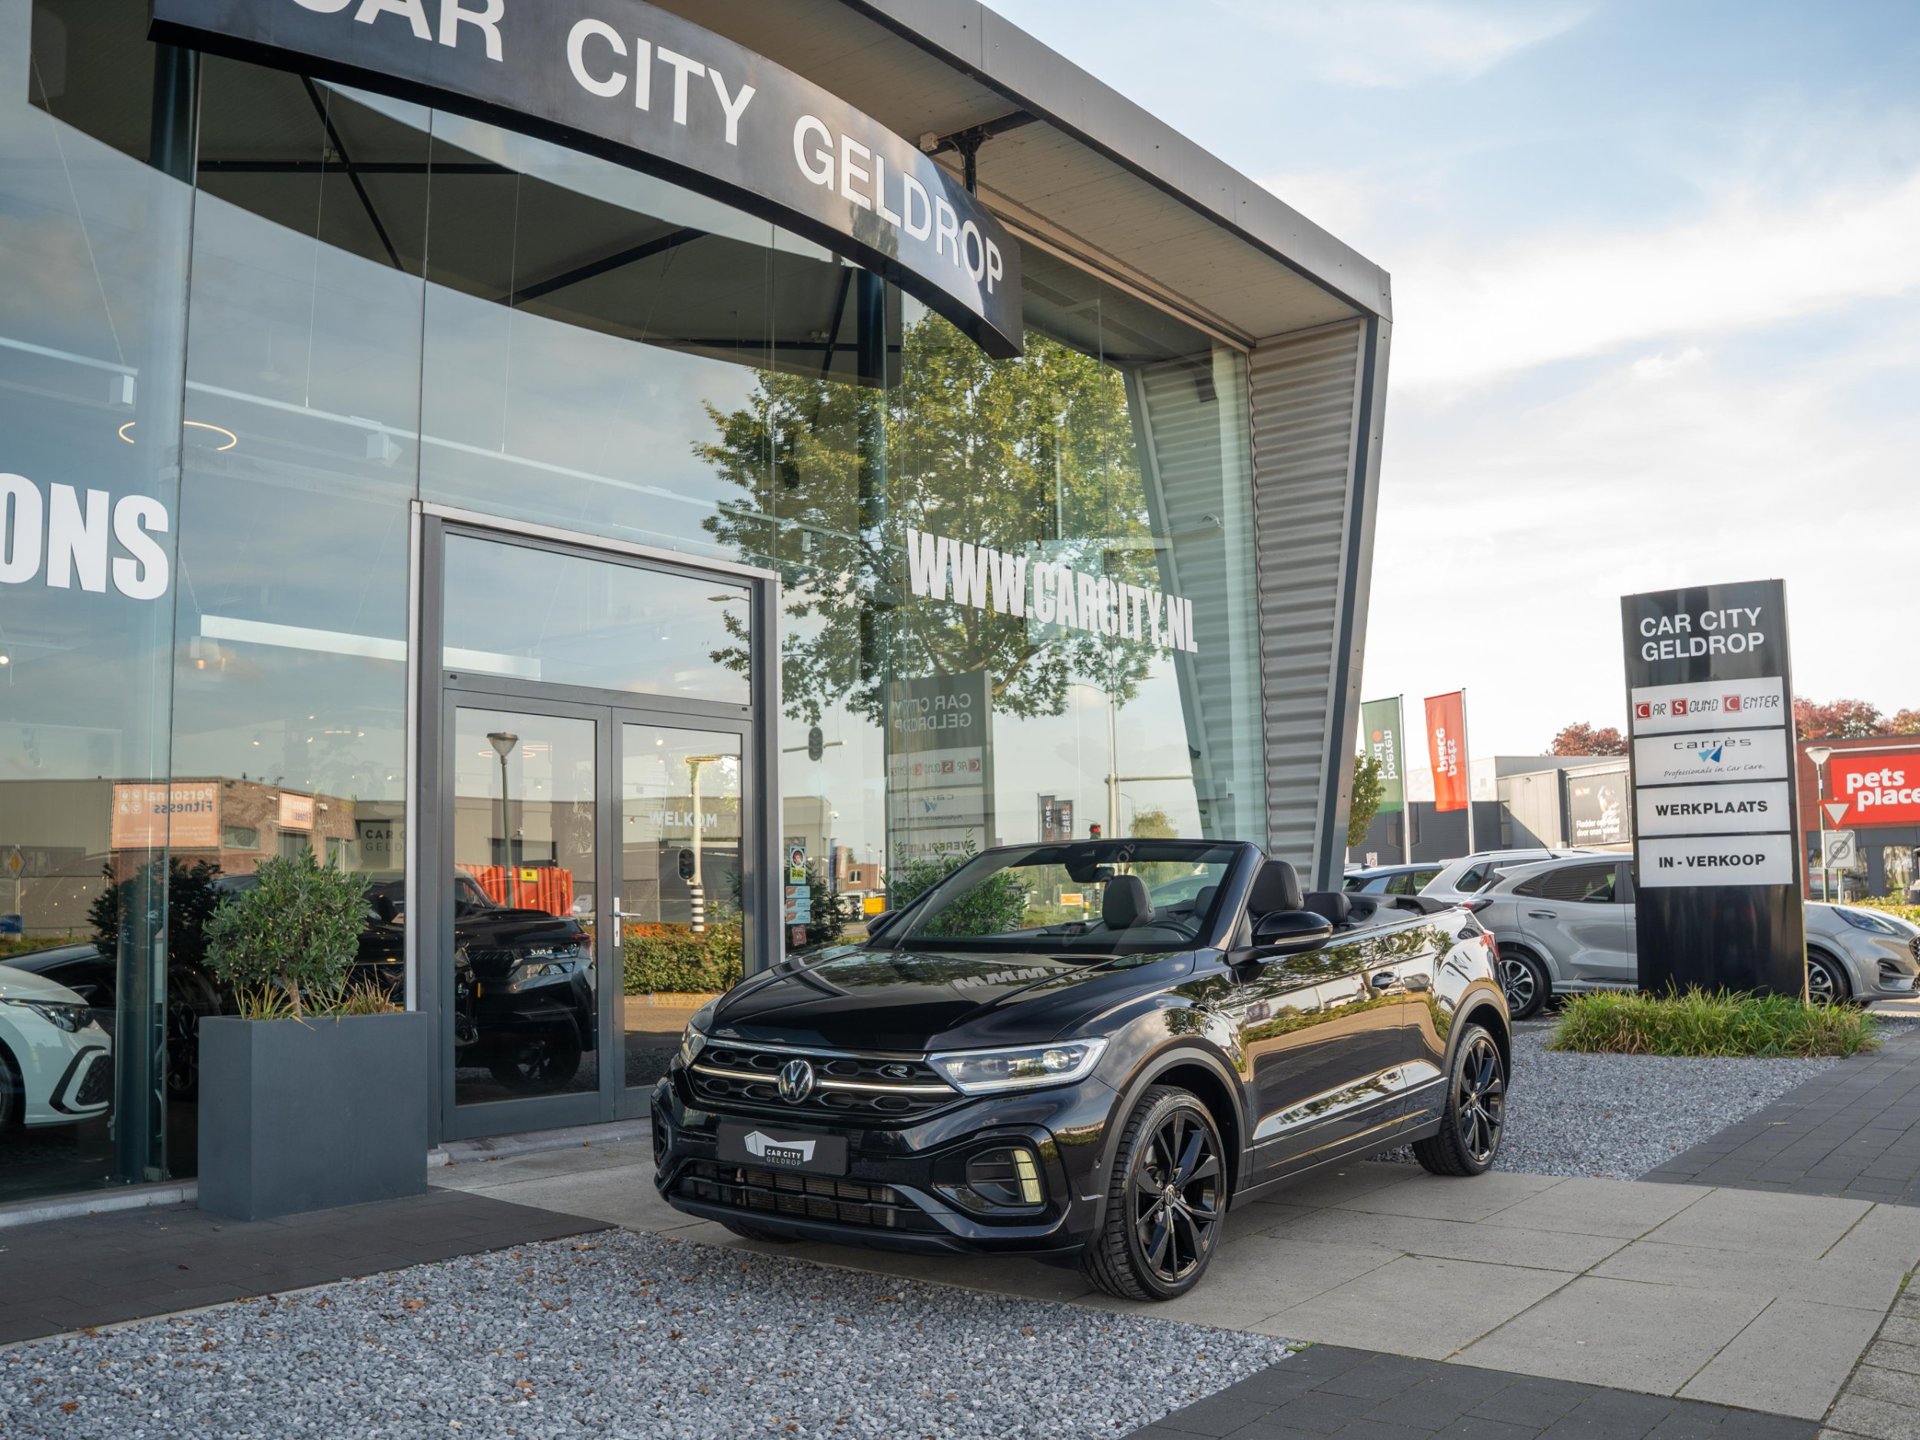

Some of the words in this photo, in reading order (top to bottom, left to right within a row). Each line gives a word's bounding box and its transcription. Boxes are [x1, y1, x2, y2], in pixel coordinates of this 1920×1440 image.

[566, 18, 756, 146] CITY
[793, 114, 1003, 295] GELDROP
[906, 528, 1198, 653] WWW.CARCITY.NL
[1640, 613, 1692, 637] CAR
[1700, 607, 1762, 631] CITY
[1641, 632, 1765, 662] GELDROP
[1636, 703, 1667, 719] CAR
[1672, 699, 1719, 715] SOUND
[1725, 695, 1780, 711] CENTER
[1673, 737, 1752, 750] carrès
[1663, 766, 1712, 779] Professionals
[1846, 768, 1905, 795] pets
[1655, 800, 1768, 817] WERKPLAATS
[648, 811, 718, 828] WELKOM
[766, 1149, 781, 1157] CAR
[783, 1151, 801, 1159] CITY
[766, 1156, 801, 1166] GELDROP
